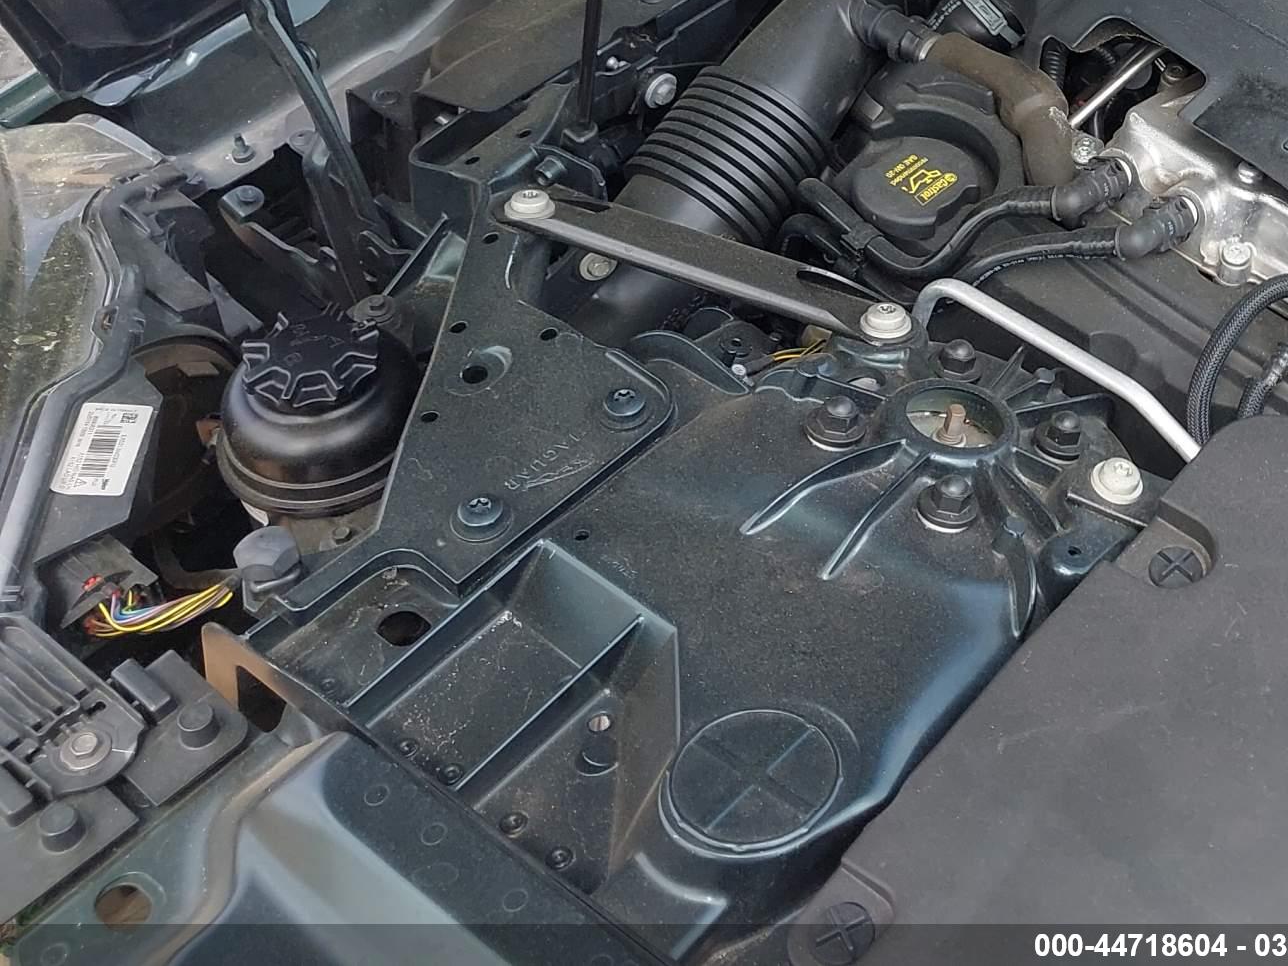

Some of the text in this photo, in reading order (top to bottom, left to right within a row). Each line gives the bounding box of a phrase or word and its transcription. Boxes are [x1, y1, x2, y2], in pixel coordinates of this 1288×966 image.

[902, 154, 918, 167] SAE
[920, 177, 948, 201] Castrol
[504, 432, 586, 491] JAGUAR
